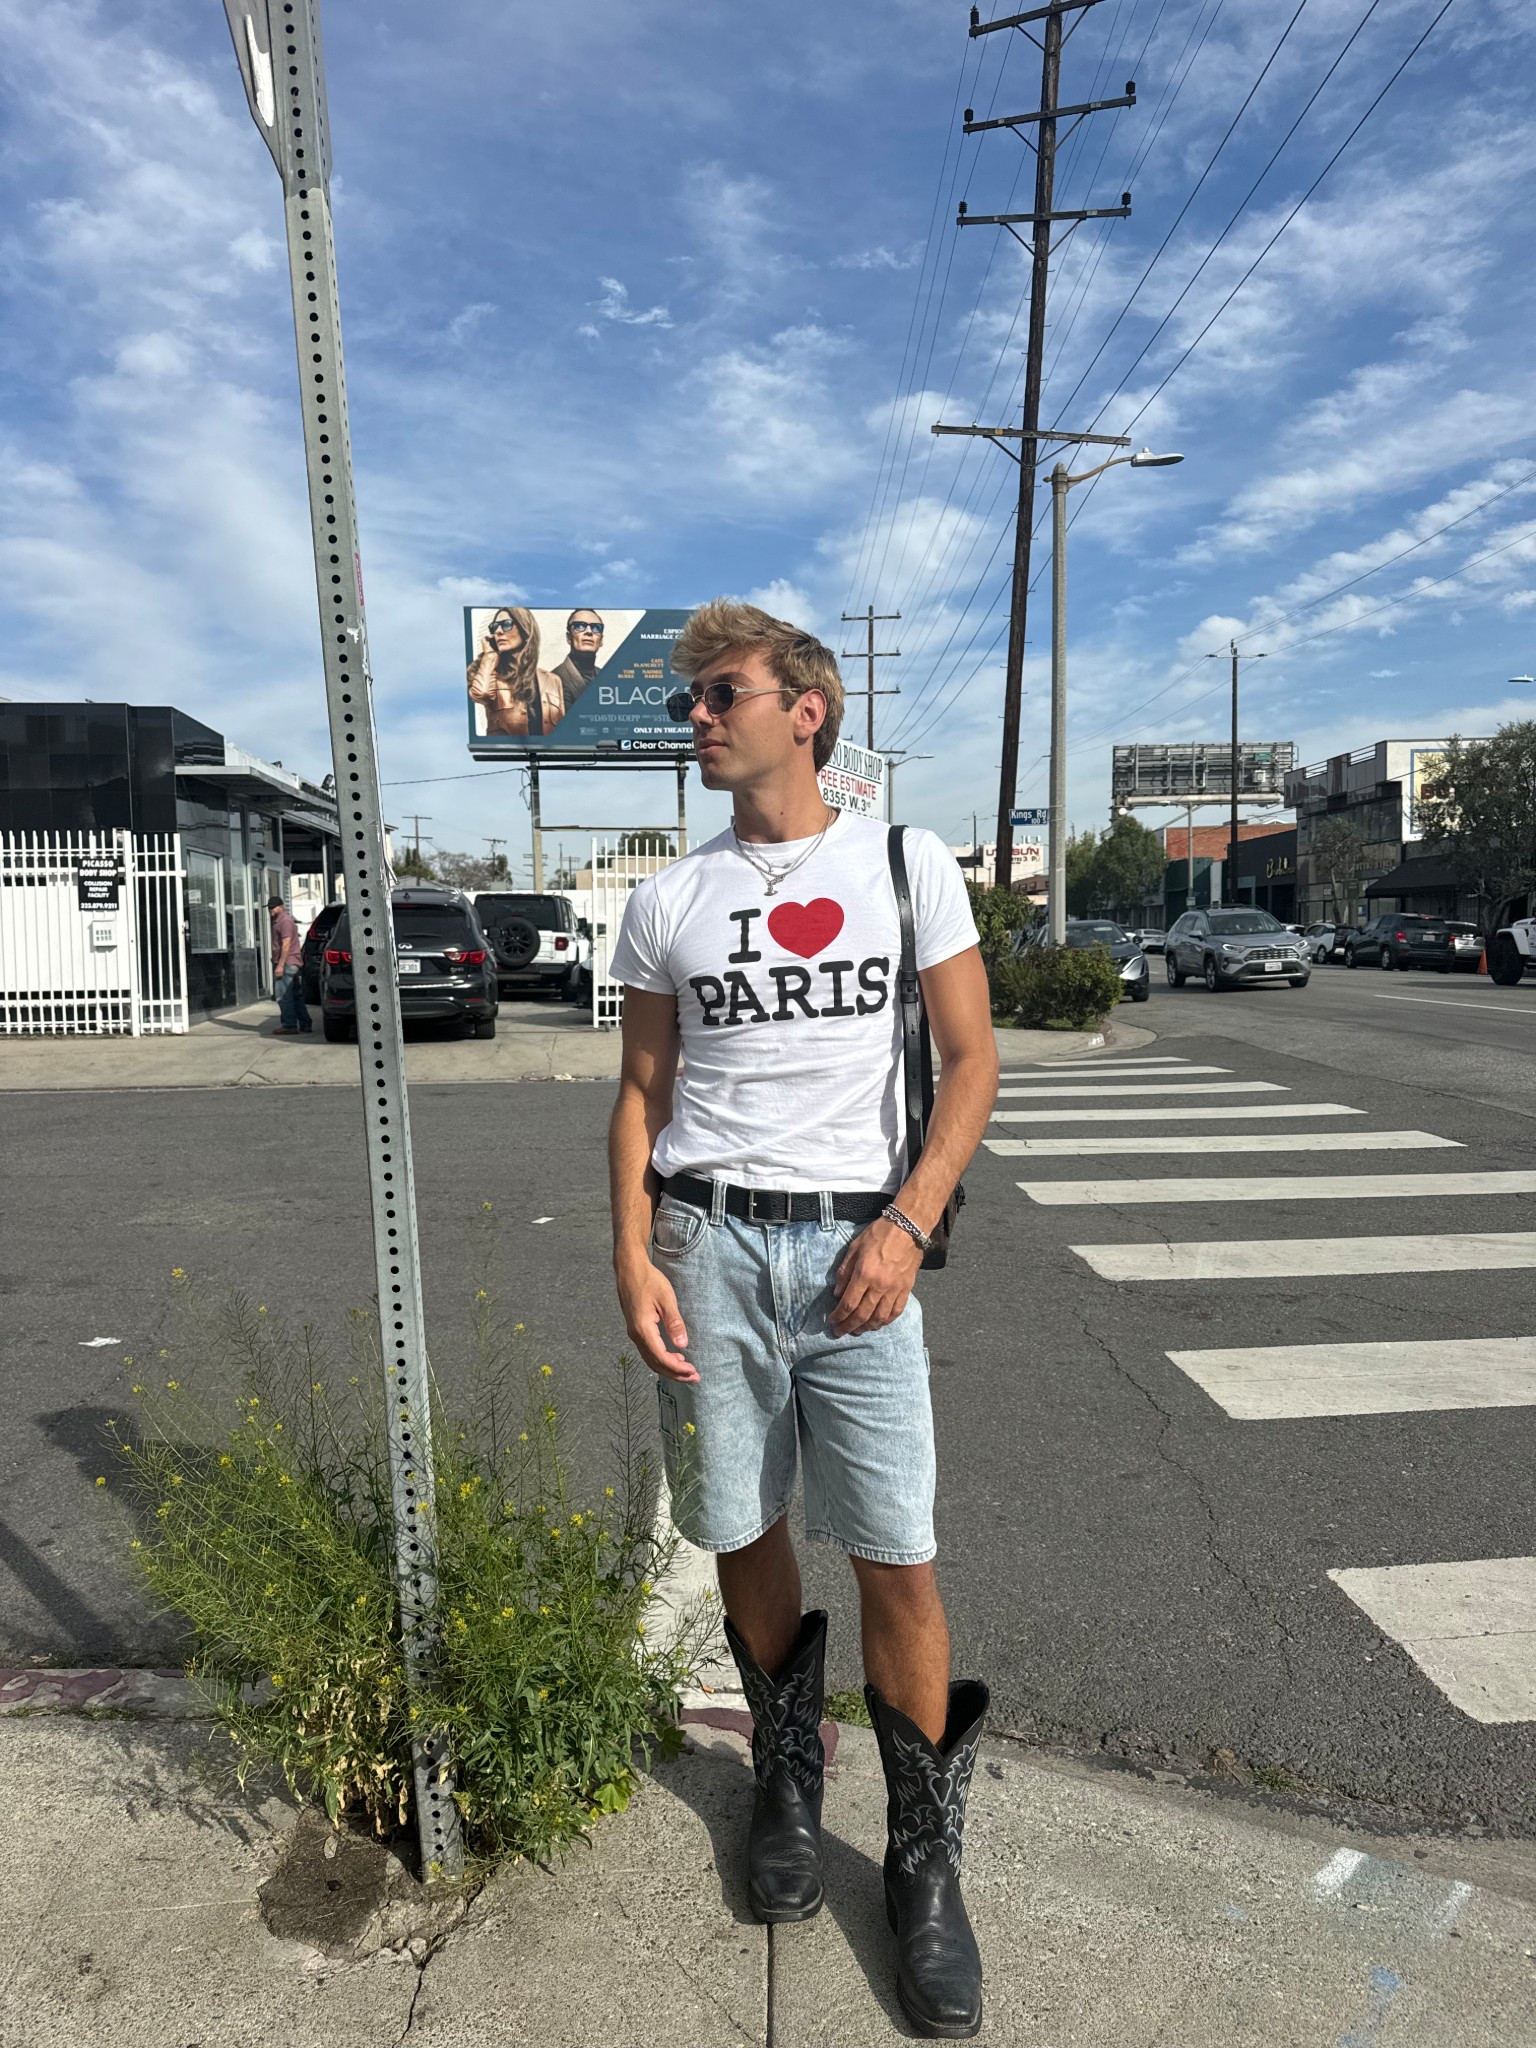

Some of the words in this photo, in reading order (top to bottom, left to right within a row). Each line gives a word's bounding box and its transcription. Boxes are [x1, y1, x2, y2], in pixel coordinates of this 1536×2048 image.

[599, 686, 678, 705] BLACK
[633, 726, 653, 734] ONLY
[654, 726, 662, 734] IN
[632, 740, 657, 750] Clear
[658, 740, 695, 750] Channel
[843, 745, 864, 774] BODY
[864, 753, 883, 780] SHOP
[840, 774, 877, 800] ESTIMATE
[823, 787, 847, 806] 8355
[849, 794, 860, 810] W.
[1011, 810, 1032, 821] Kings
[1036, 809, 1047, 818] Rd
[80, 869, 98, 877] BODY
[98, 869, 117, 877] SHOP
[82, 860, 114, 868] PICASSO
[728, 908, 762, 964] I
[689, 956, 890, 1026] PARIS
